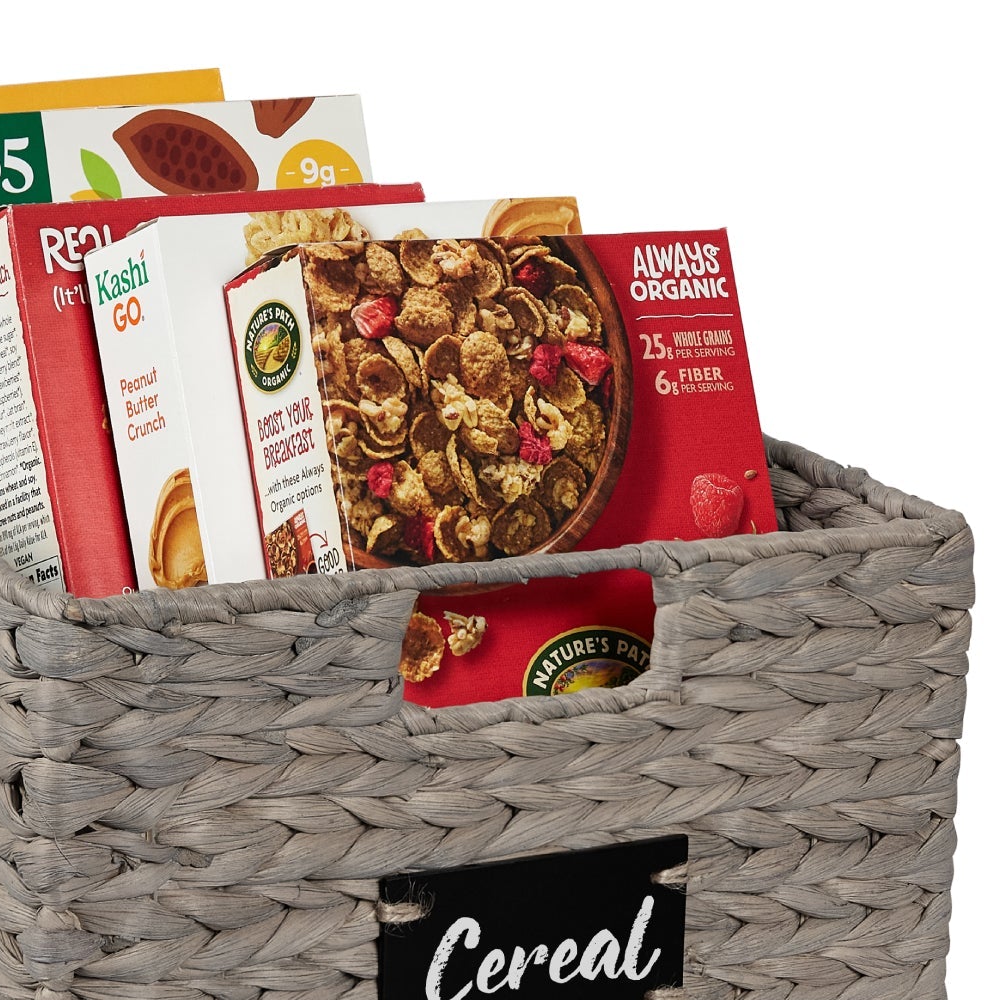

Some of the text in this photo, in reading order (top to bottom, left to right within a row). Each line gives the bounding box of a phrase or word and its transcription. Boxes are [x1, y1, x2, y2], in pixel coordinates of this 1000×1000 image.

[300, 157, 336, 187] 9g
[634, 241, 720, 278] ALWAYS
[95, 249, 150, 306] Kashi
[630, 277, 729, 301] ORGANIC
[246, 307, 295, 351] NATURE'S PATH
[639, 330, 733, 360] 25g WHOLE GRAINS
[676, 347, 735, 359] PER SERVING
[119, 366, 158, 397] Peanut
[262, 363, 291, 387] ORGANIC
[655, 367, 723, 395] 6g FIBER
[681, 381, 734, 393] PER SERVING
[126, 392, 159, 419] Butter
[127, 412, 166, 442] Crunch
[282, 472, 300, 489] these
[301, 462, 325, 480] Always
[270, 483, 323, 514] Organic options
[14, 552, 33, 567] VEGAN
[36, 564, 59, 583] Facts
[532, 637, 650, 690] NATURE'S PAT
